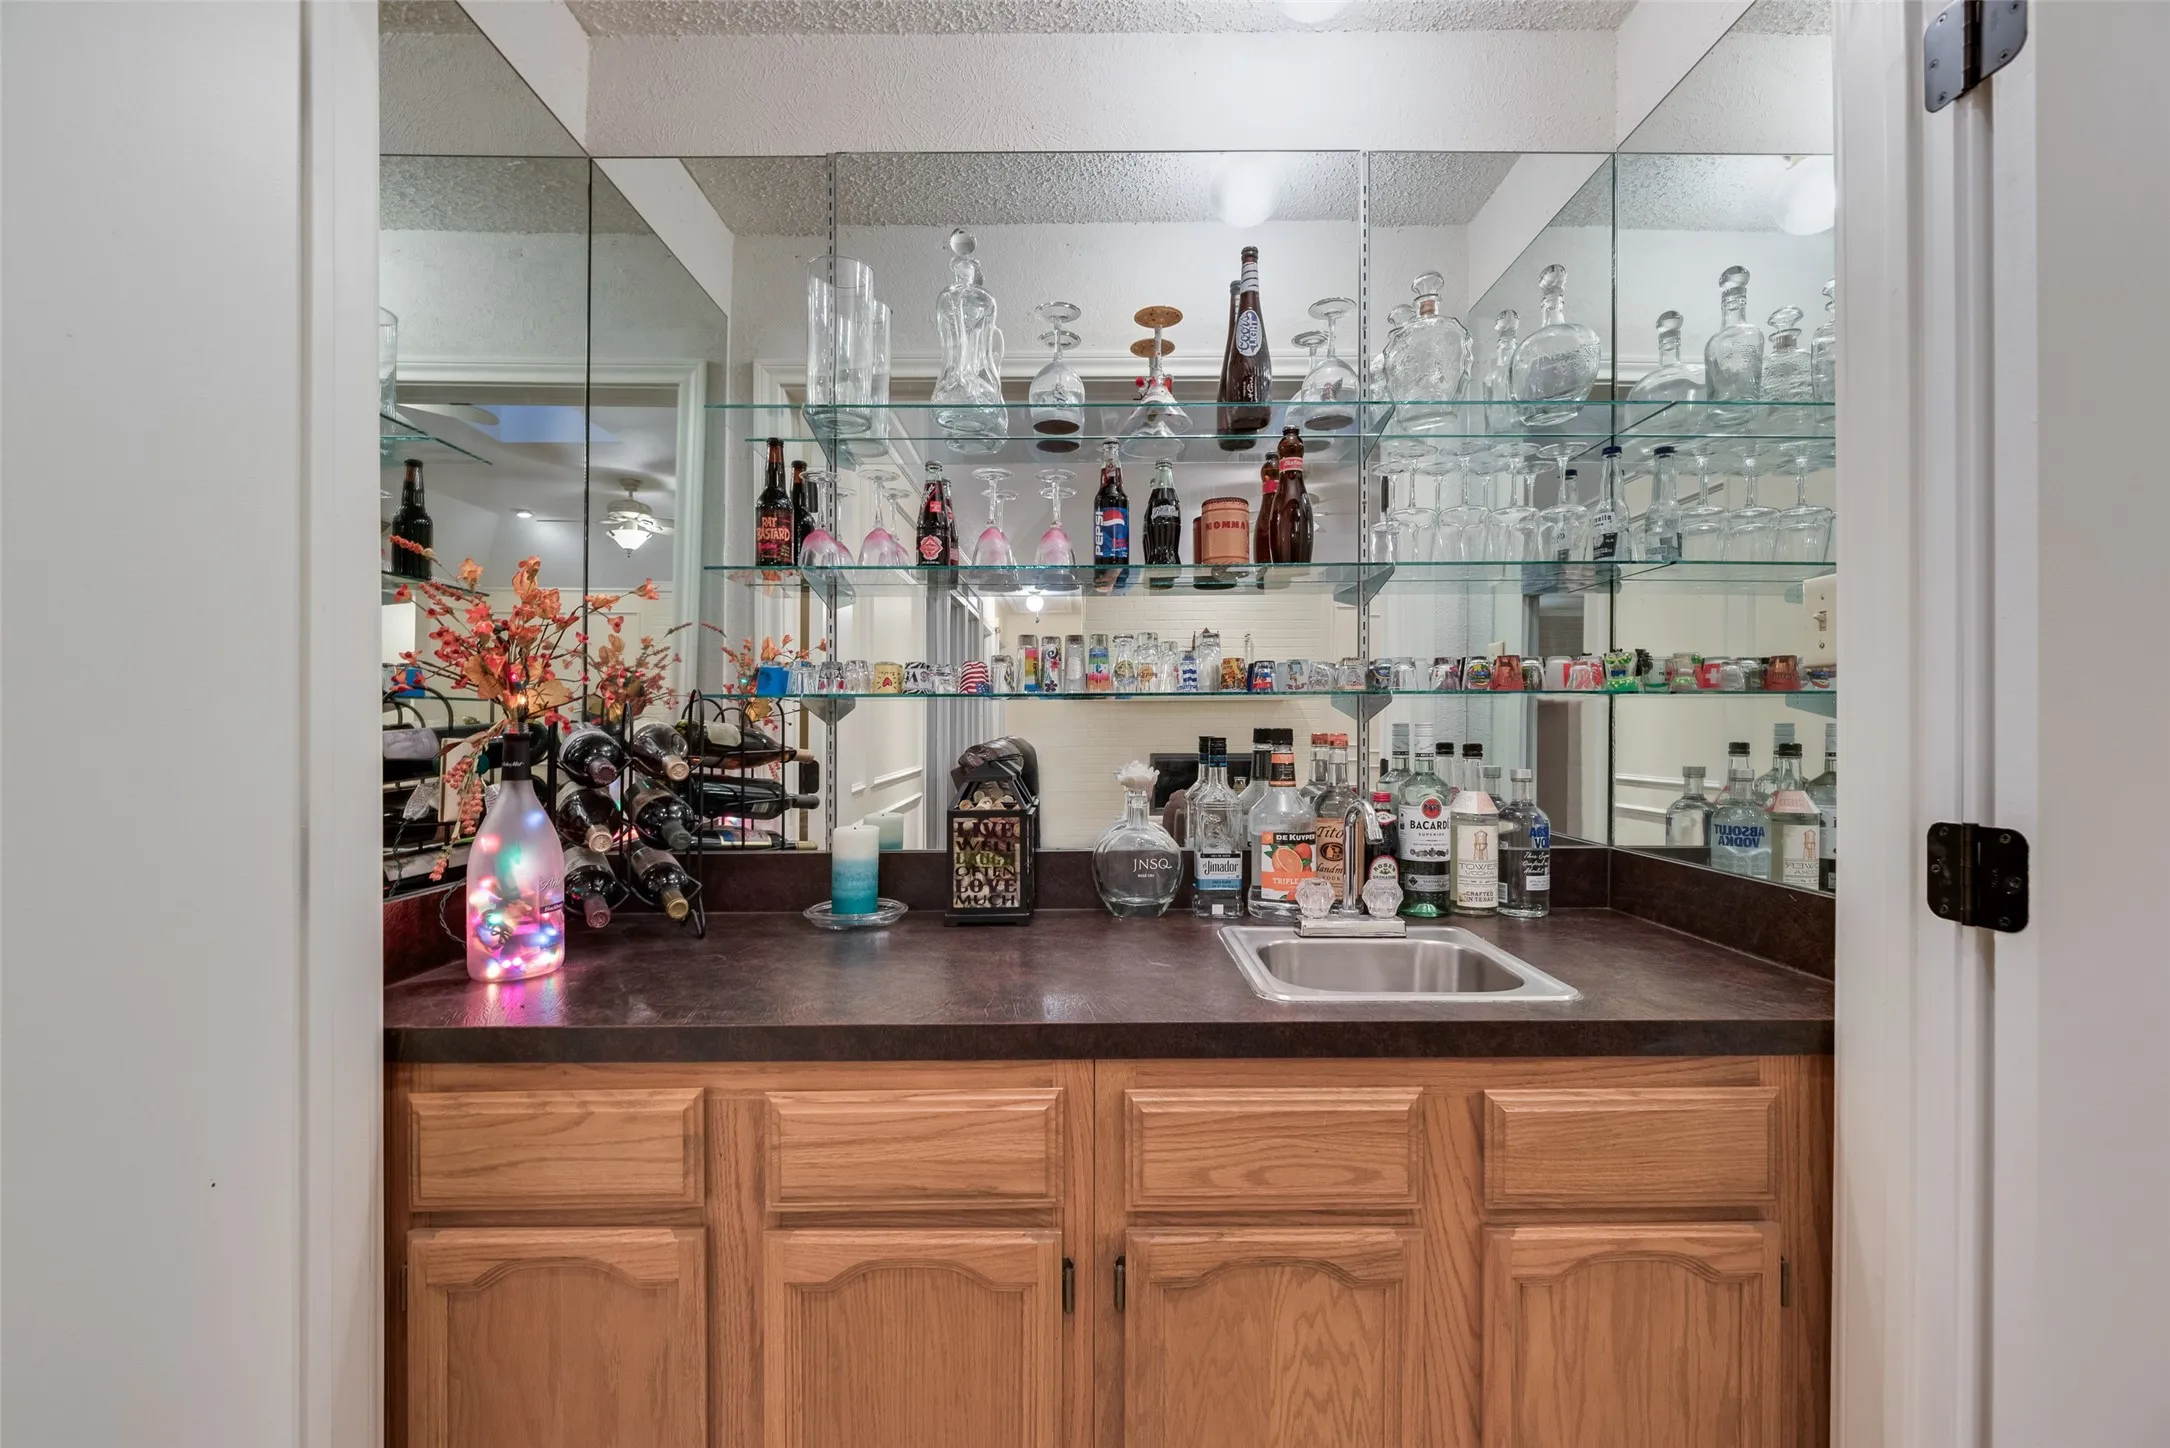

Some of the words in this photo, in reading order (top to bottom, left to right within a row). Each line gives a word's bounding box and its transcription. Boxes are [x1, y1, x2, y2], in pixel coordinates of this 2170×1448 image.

[1249, 320, 1258, 346] LIGHT
[761, 517, 777, 527] RAT
[756, 528, 790, 541] BASTARD
[1095, 506, 1104, 556] PEPSI
[1276, 833, 1288, 841] DE
[1133, 858, 1172, 872] JNSQ
[1204, 860, 1239, 875] Jimador
[955, 879, 1017, 894] LOVE
[1272, 877, 1299, 885] TRIPLE
[955, 895, 1015, 907] MUCH
